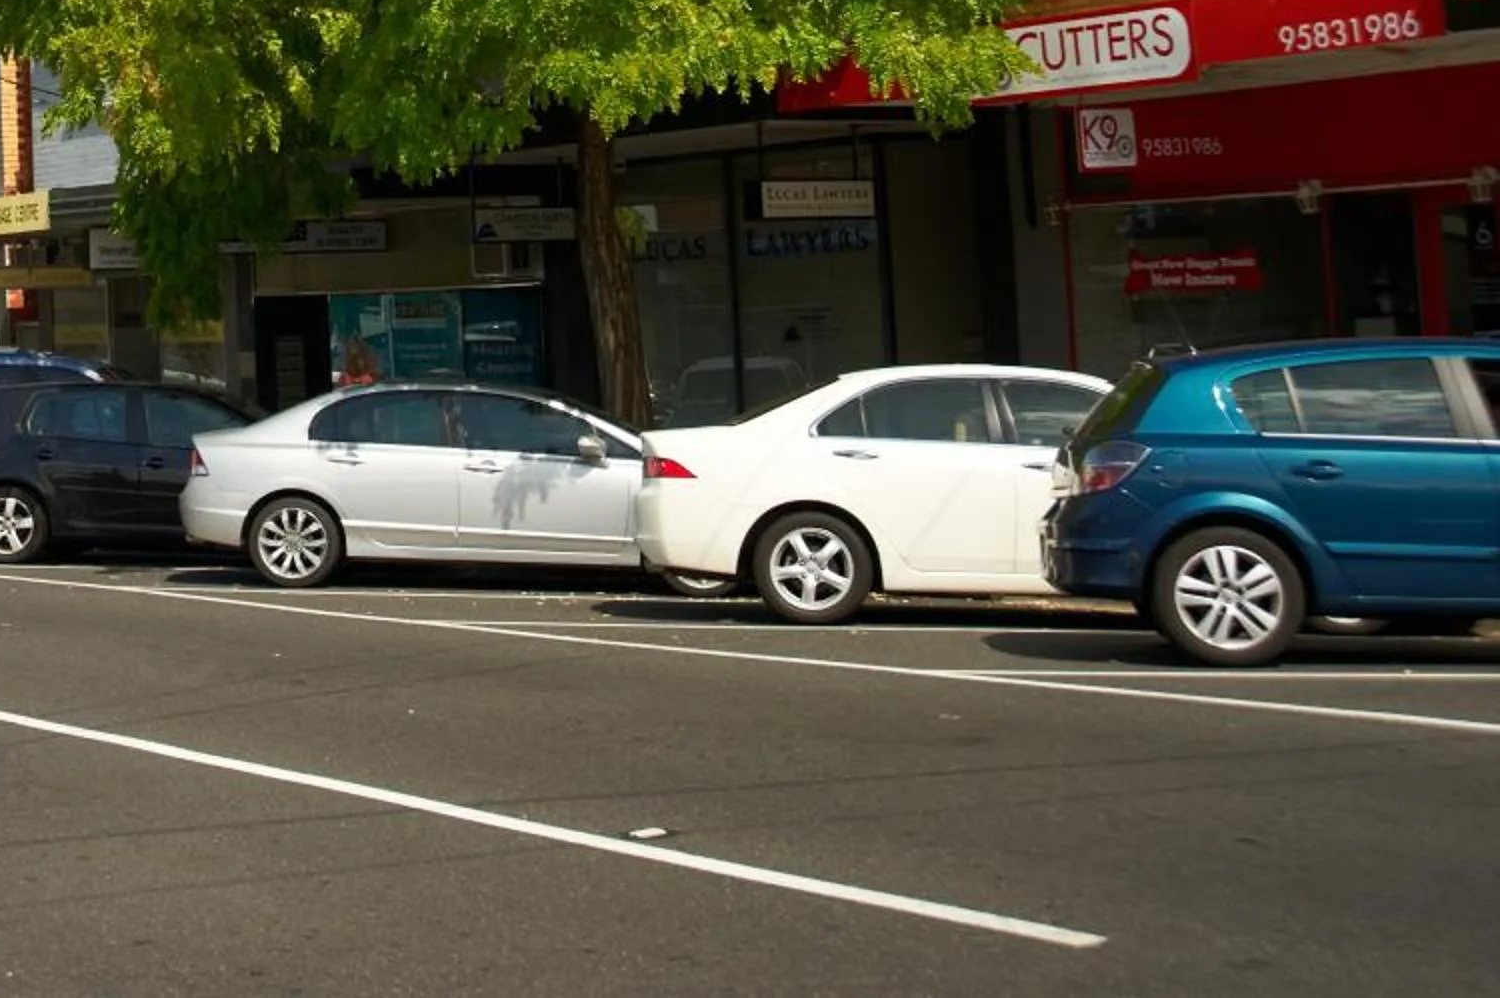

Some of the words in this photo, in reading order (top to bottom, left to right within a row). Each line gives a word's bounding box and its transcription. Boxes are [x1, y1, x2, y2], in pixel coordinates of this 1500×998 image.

[1278, 10, 1420, 52] 95831986
[1082, 114, 1118, 151] K9
[1142, 137, 1223, 157] 95831986
[1474, 221, 1493, 245] 6
